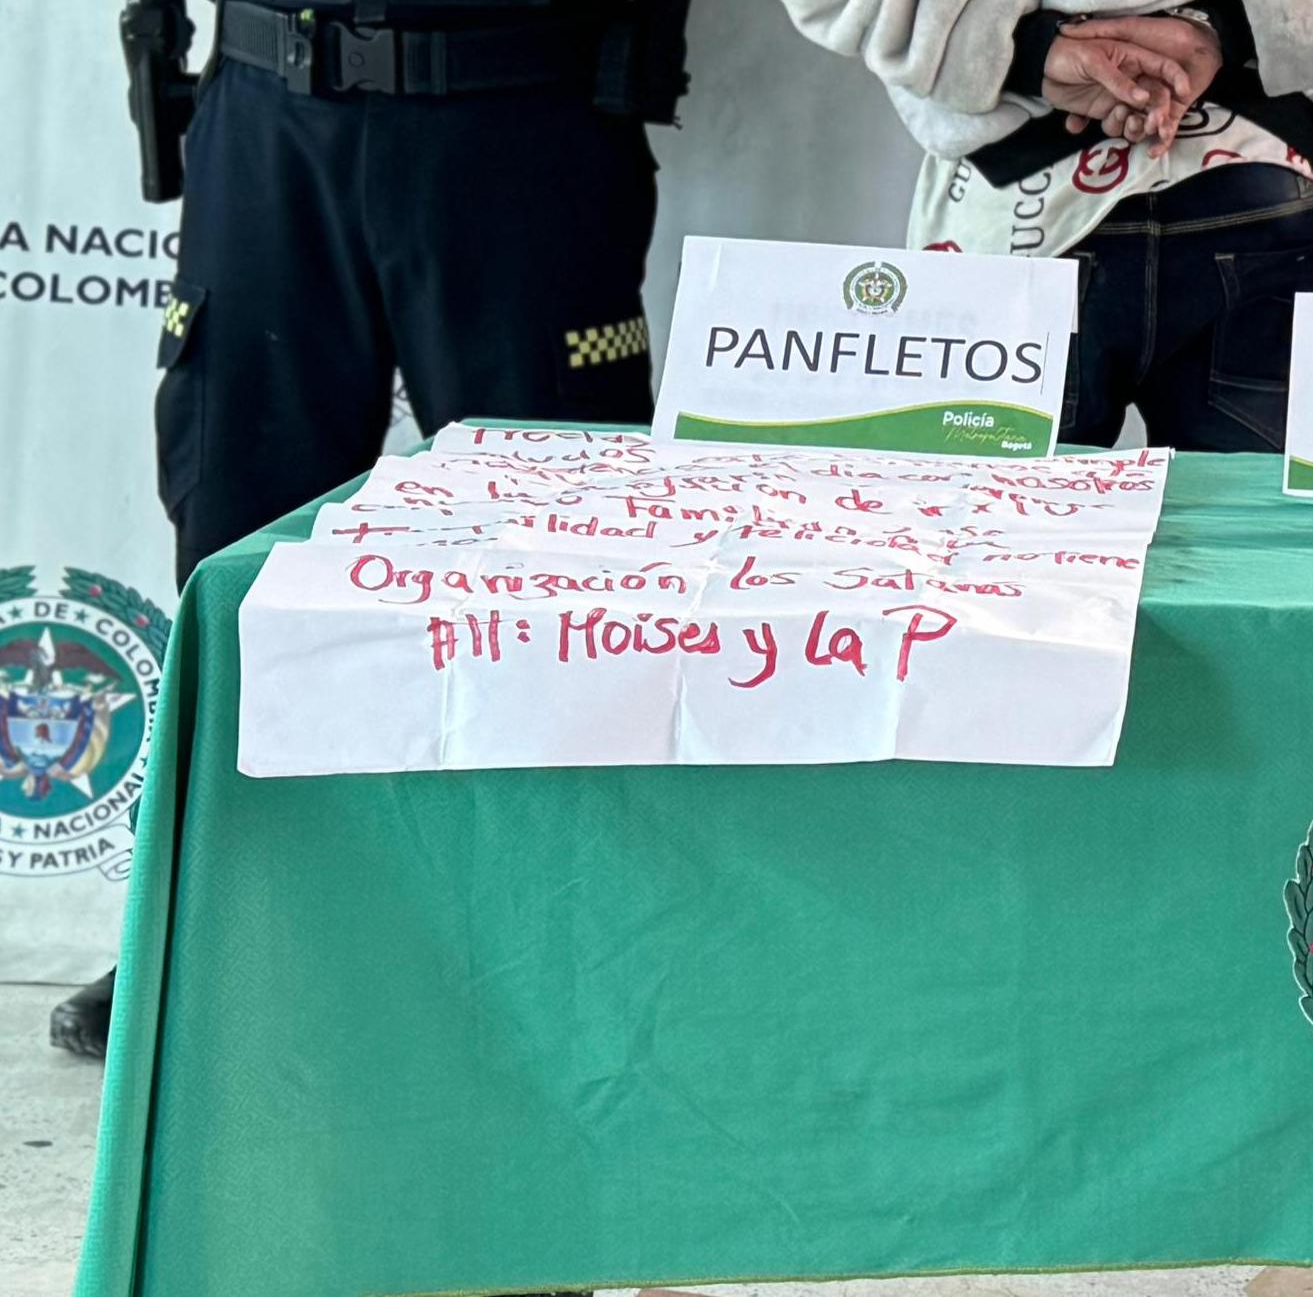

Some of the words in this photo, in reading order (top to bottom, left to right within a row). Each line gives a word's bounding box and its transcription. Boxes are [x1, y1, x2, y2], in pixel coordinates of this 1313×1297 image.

[706, 327, 1041, 383] PANFLETOS
[943, 410, 995, 428] Policía
[35, 602, 70, 621] DE
[882, 604, 958, 683] P
[29, 837, 116, 870] PATRIA
